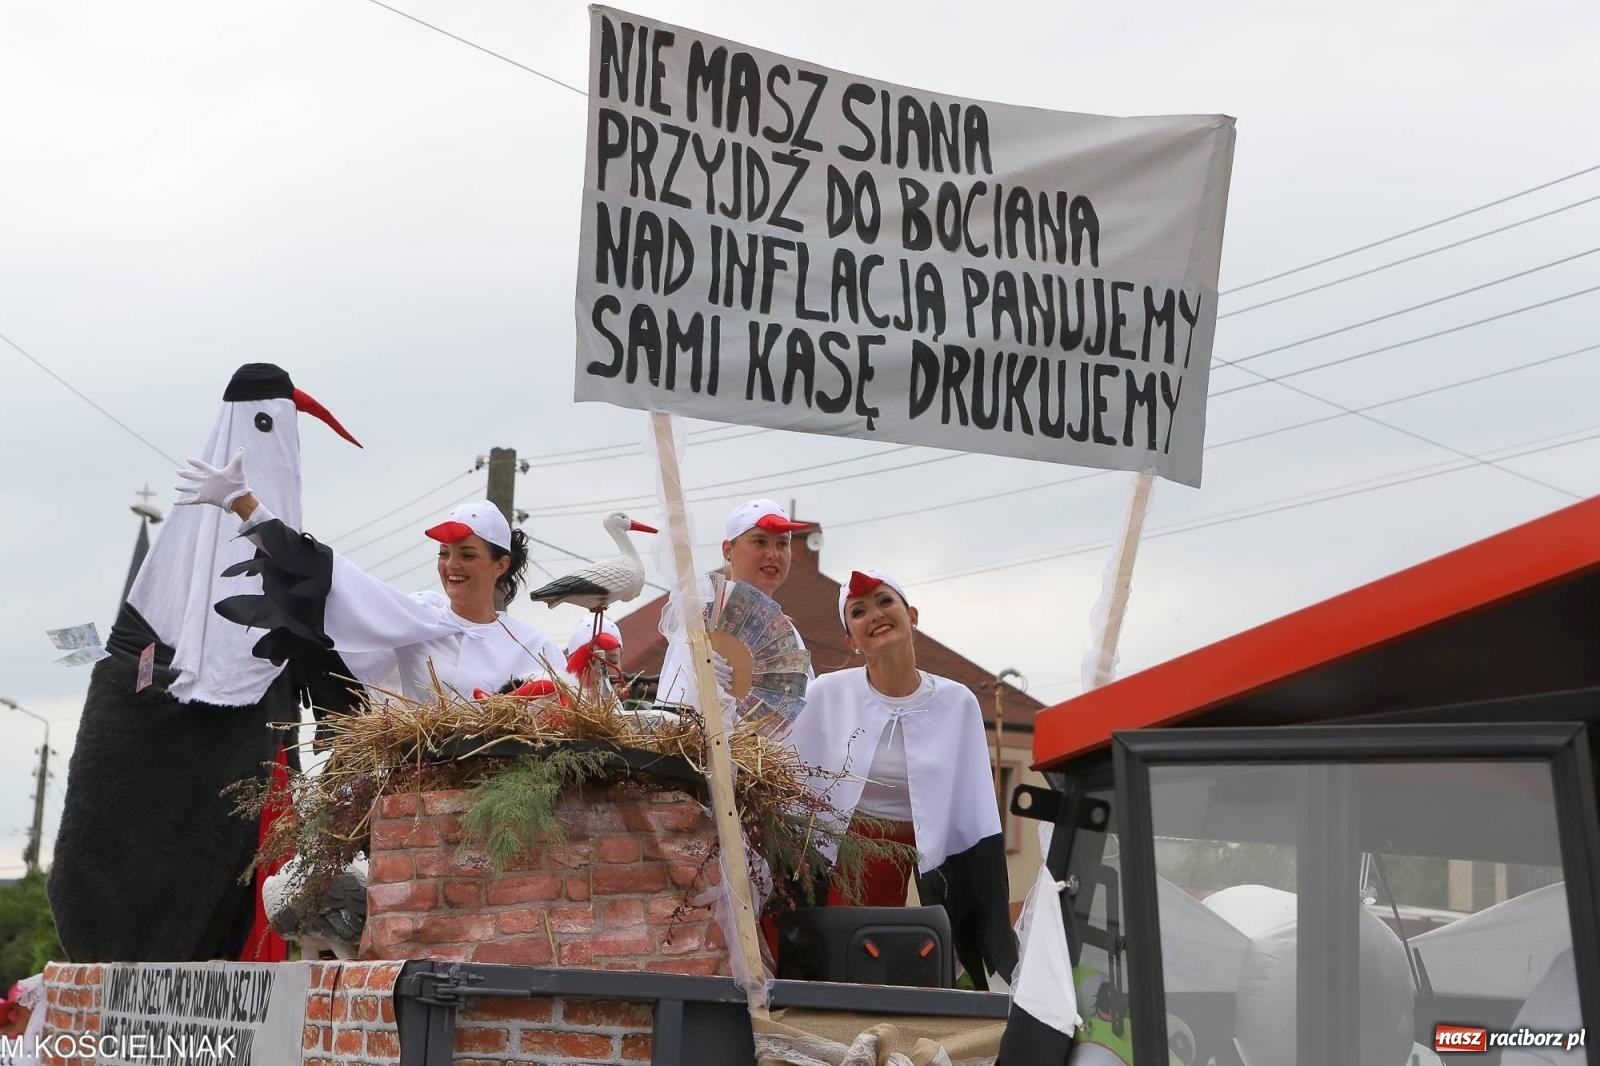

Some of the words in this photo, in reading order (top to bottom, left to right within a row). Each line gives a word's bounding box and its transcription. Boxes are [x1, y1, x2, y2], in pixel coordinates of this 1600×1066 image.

[598, 14, 676, 117] NIE
[686, 39, 829, 153] MASZ
[837, 83, 994, 176] SIANA
[596, 107, 811, 234] PRZYJDŹ
[825, 164, 882, 245] DO
[898, 176, 1100, 268] BOCIANA
[595, 201, 695, 297] NAD
[707, 224, 947, 343] INFLACJĄ
[961, 266, 1202, 370] PANUJEMY
[586, 294, 721, 398] SAMI
[744, 320, 887, 432] KASĘ
[908, 338, 1183, 455] DRUKUJEMY
[231, 969, 251, 1023] BEZ
